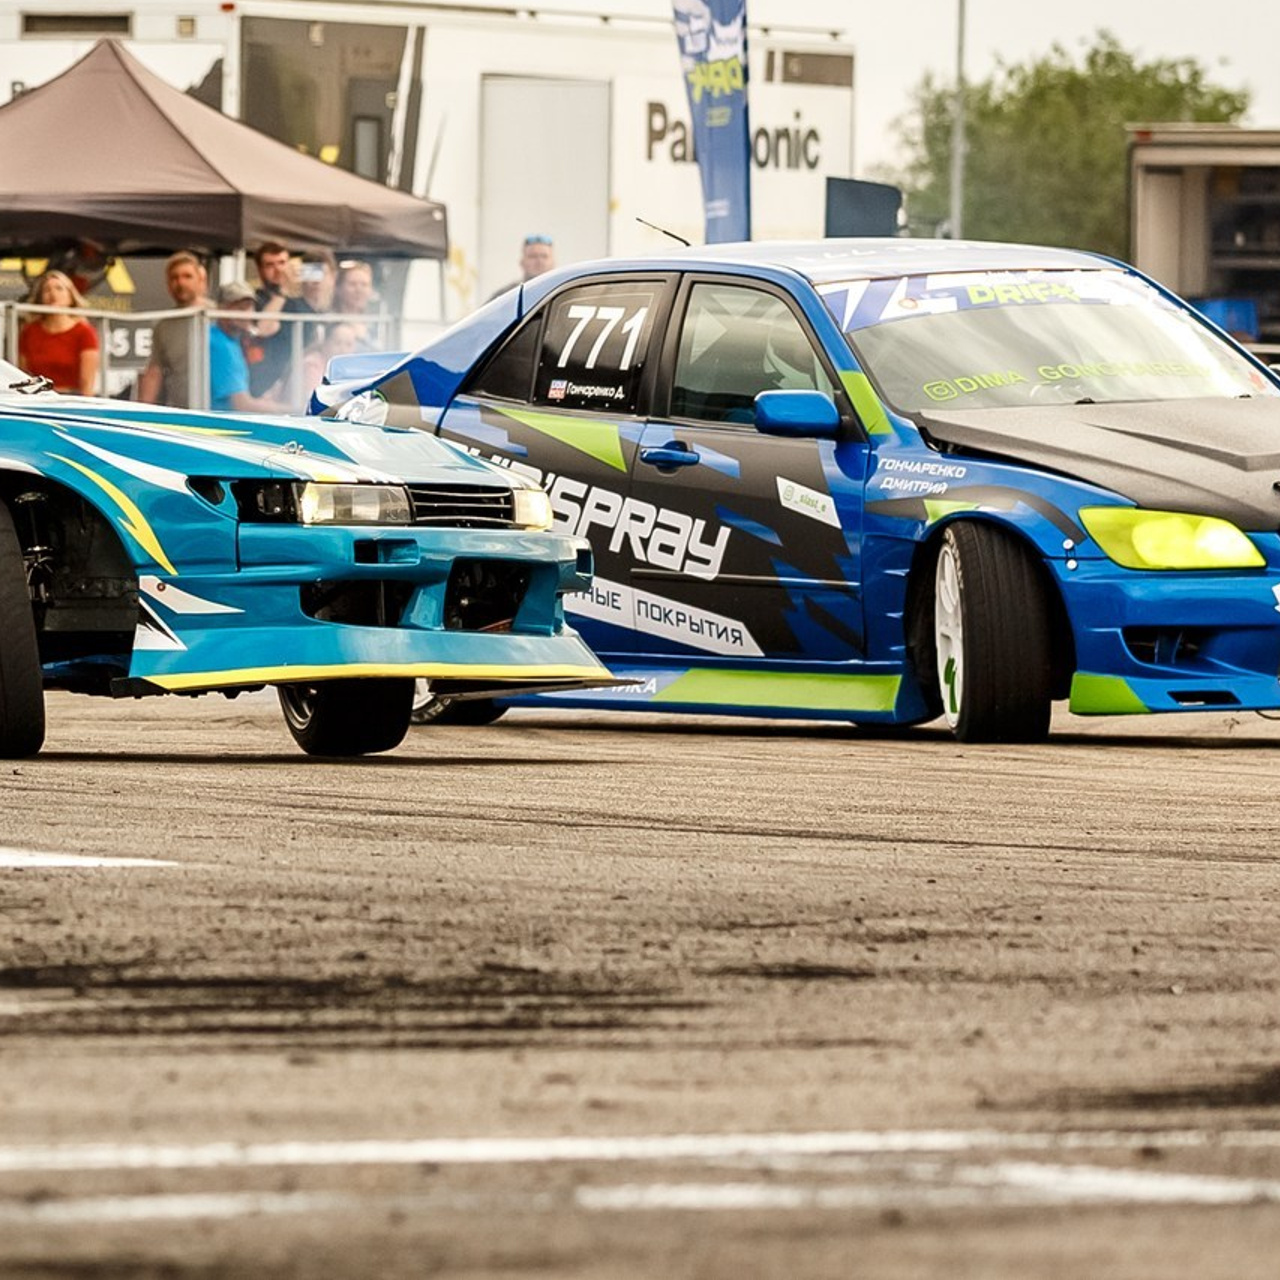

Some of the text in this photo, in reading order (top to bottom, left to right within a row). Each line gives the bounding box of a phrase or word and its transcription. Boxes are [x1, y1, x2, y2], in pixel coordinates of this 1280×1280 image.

[646, 96, 821, 169] Paonic
[557, 305, 649, 371] 771
[877, 457, 967, 479] ГОНЧАРЕНКО
[879, 476, 949, 495] ДМИТРИЙ
[636, 599, 744, 647] ПОКРЫТИЯ
